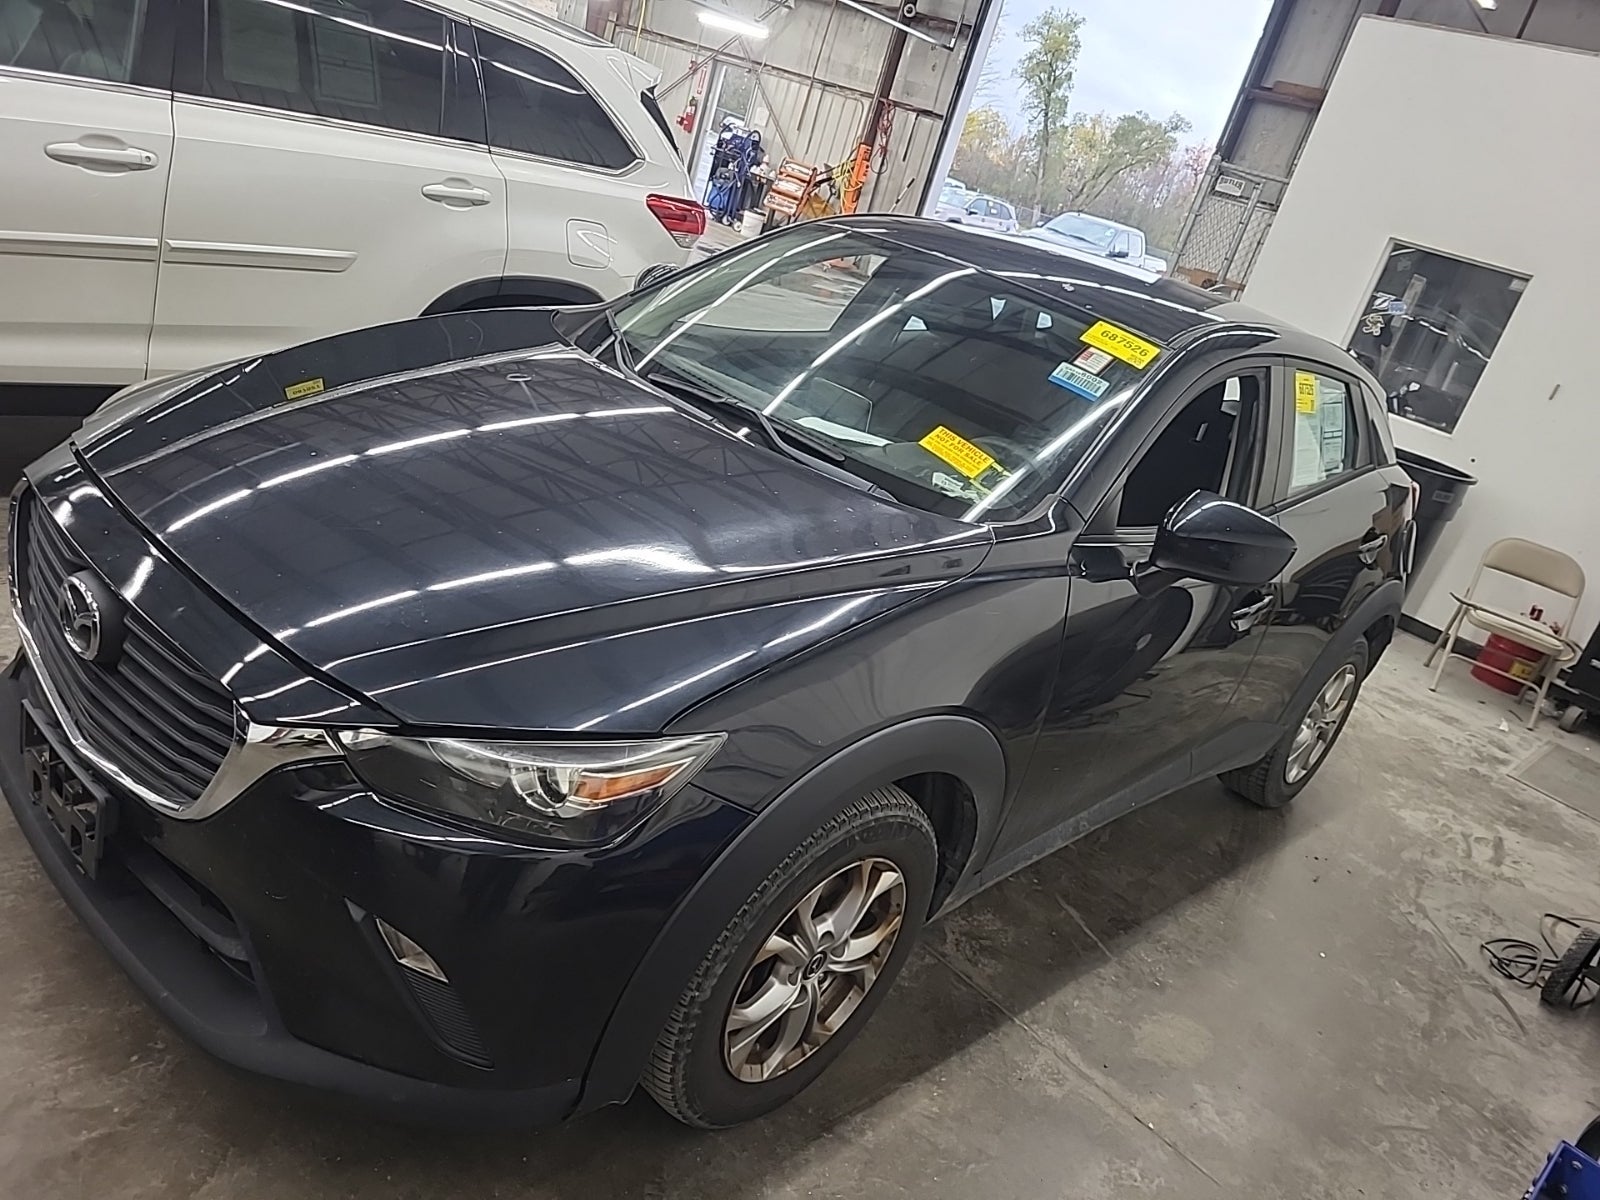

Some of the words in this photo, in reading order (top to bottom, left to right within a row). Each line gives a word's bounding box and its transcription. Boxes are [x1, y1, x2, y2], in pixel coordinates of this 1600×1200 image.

[1100, 329, 1150, 357] 687526
[934, 433, 949, 444] NOT
[949, 443, 964, 454] FOR
[965, 451, 983, 465] SALE
[939, 428, 957, 442] THIS
[957, 440, 990, 463] VEHICLE
